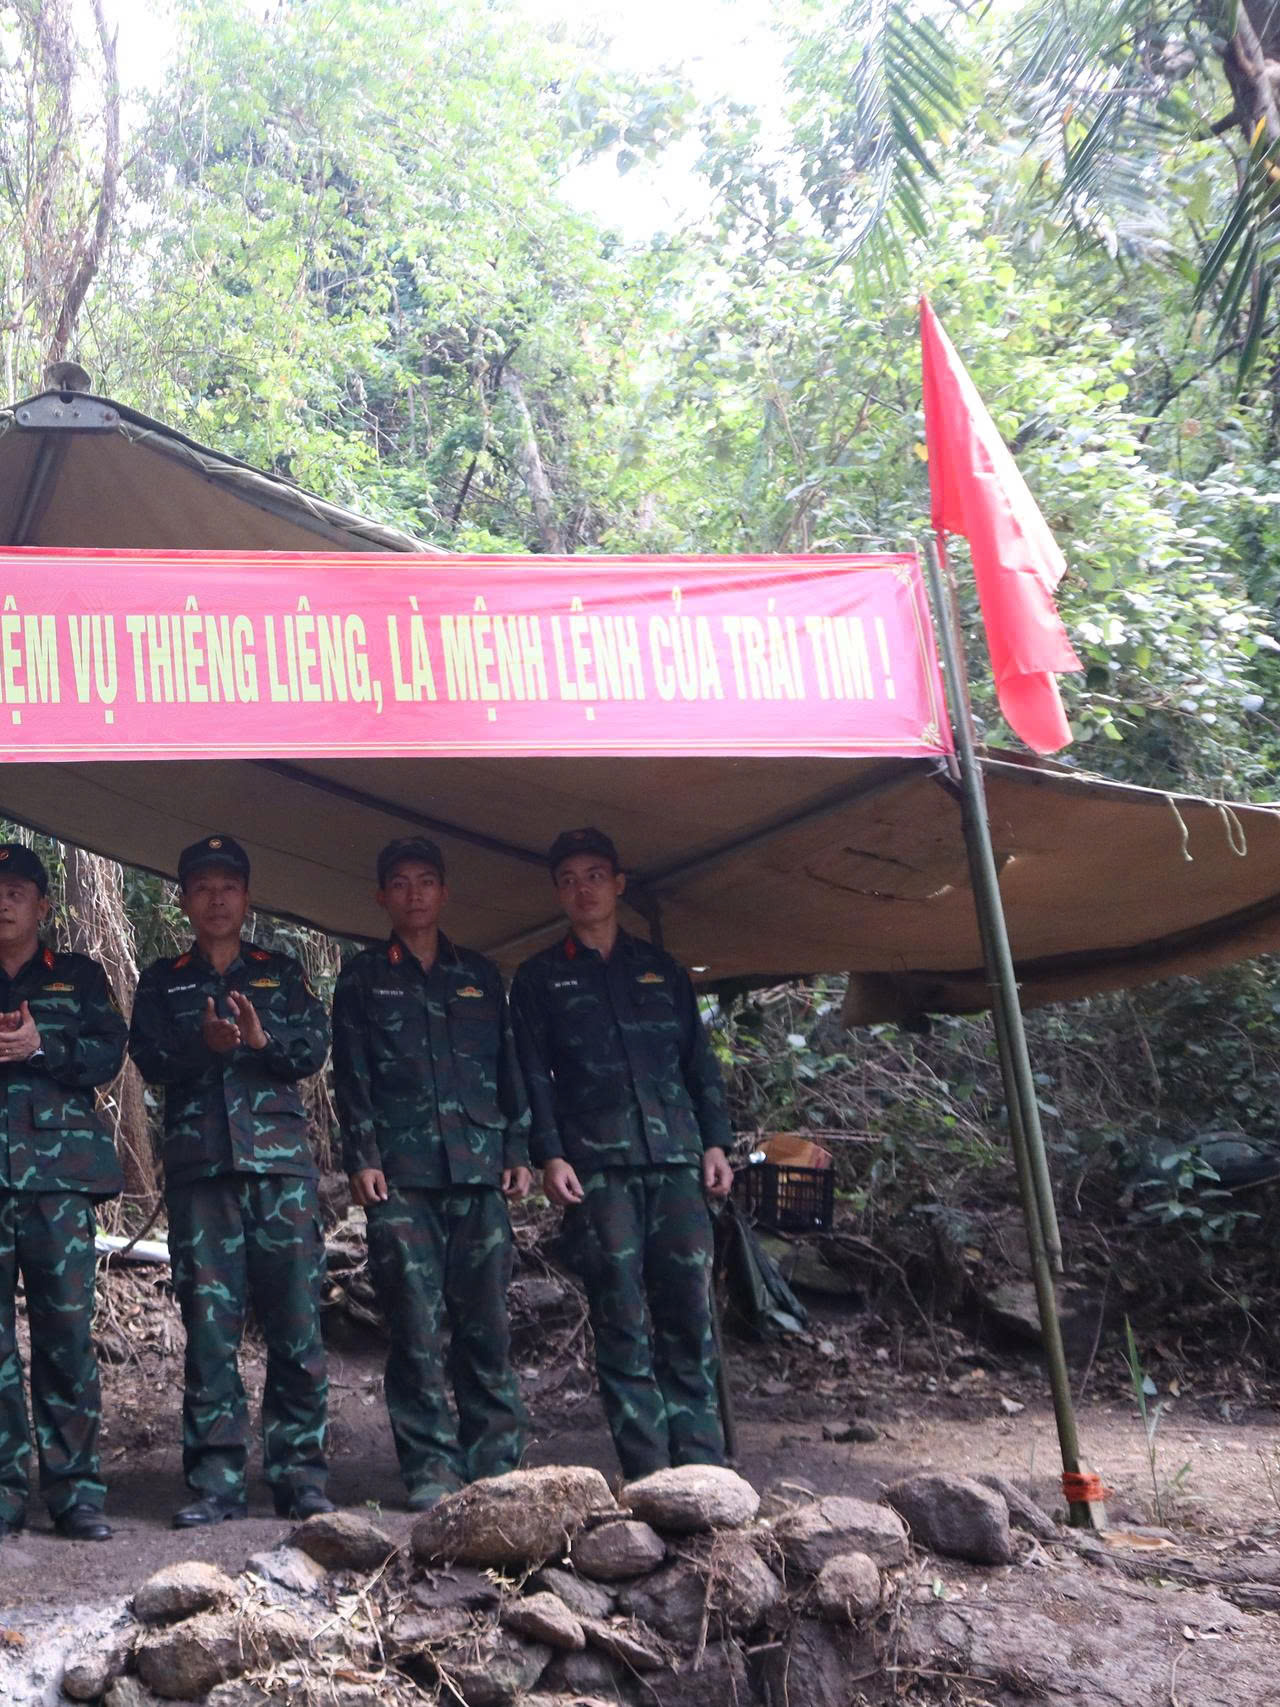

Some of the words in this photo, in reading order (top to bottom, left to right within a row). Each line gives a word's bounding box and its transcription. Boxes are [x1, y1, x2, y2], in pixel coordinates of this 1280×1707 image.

[68, 614, 119, 725] VỤ
[125, 595, 260, 704] THIÊNG
[263, 595, 384, 714] LIÊNG,
[387, 595, 438, 702] LÀ
[440, 595, 548, 722] MỆNH
[552, 595, 646, 721] LỆNH
[648, 585, 724, 702] CỦA
[723, 597, 806, 700] TRÁI
[804, 615, 875, 700] TIM
